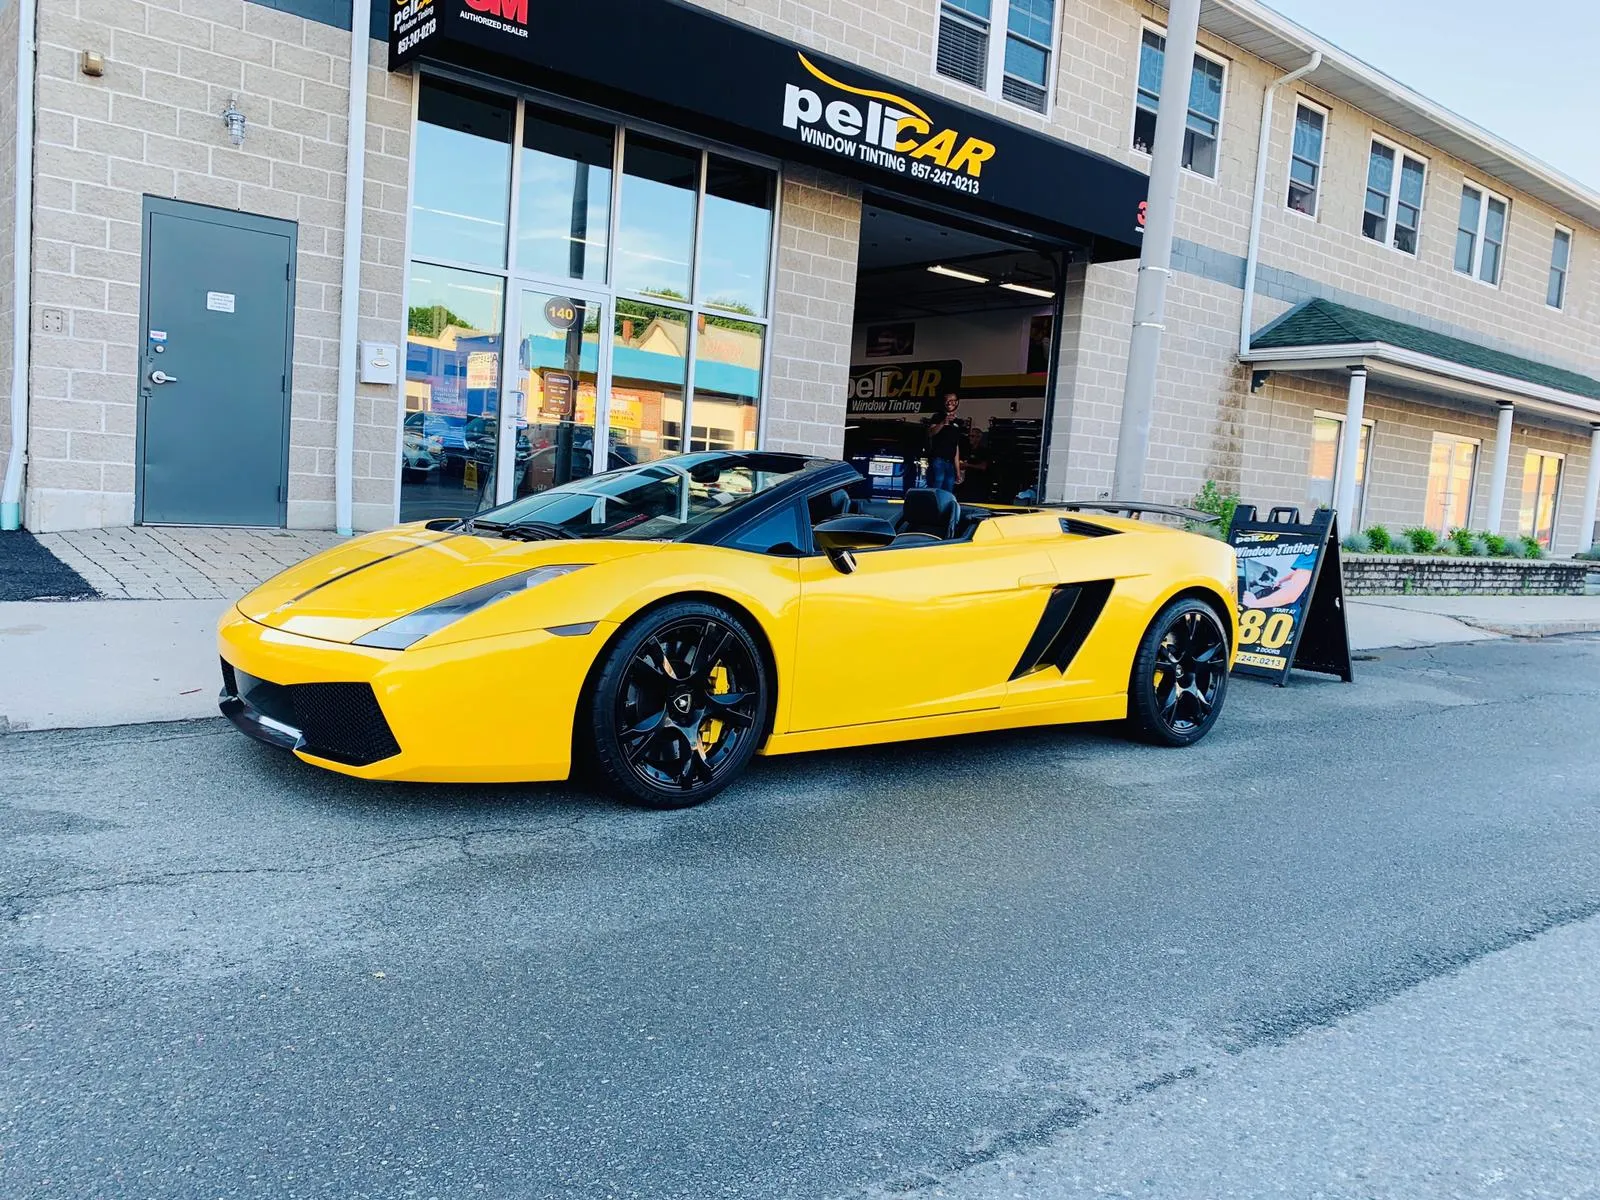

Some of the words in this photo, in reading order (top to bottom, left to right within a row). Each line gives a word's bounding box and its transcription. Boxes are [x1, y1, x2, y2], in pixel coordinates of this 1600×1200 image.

[459, 10, 502, 30] AUTHORIZED
[502, 23, 529, 38] DEALER
[782, 83, 996, 178] peliCAR
[800, 125, 857, 157] WINDOW
[858, 144, 906, 173] TINTING
[911, 161, 980, 194] 857-247-0213
[549, 306, 574, 320] 140
[852, 400, 887, 412] Window
[887, 399, 922, 413] Tinting
